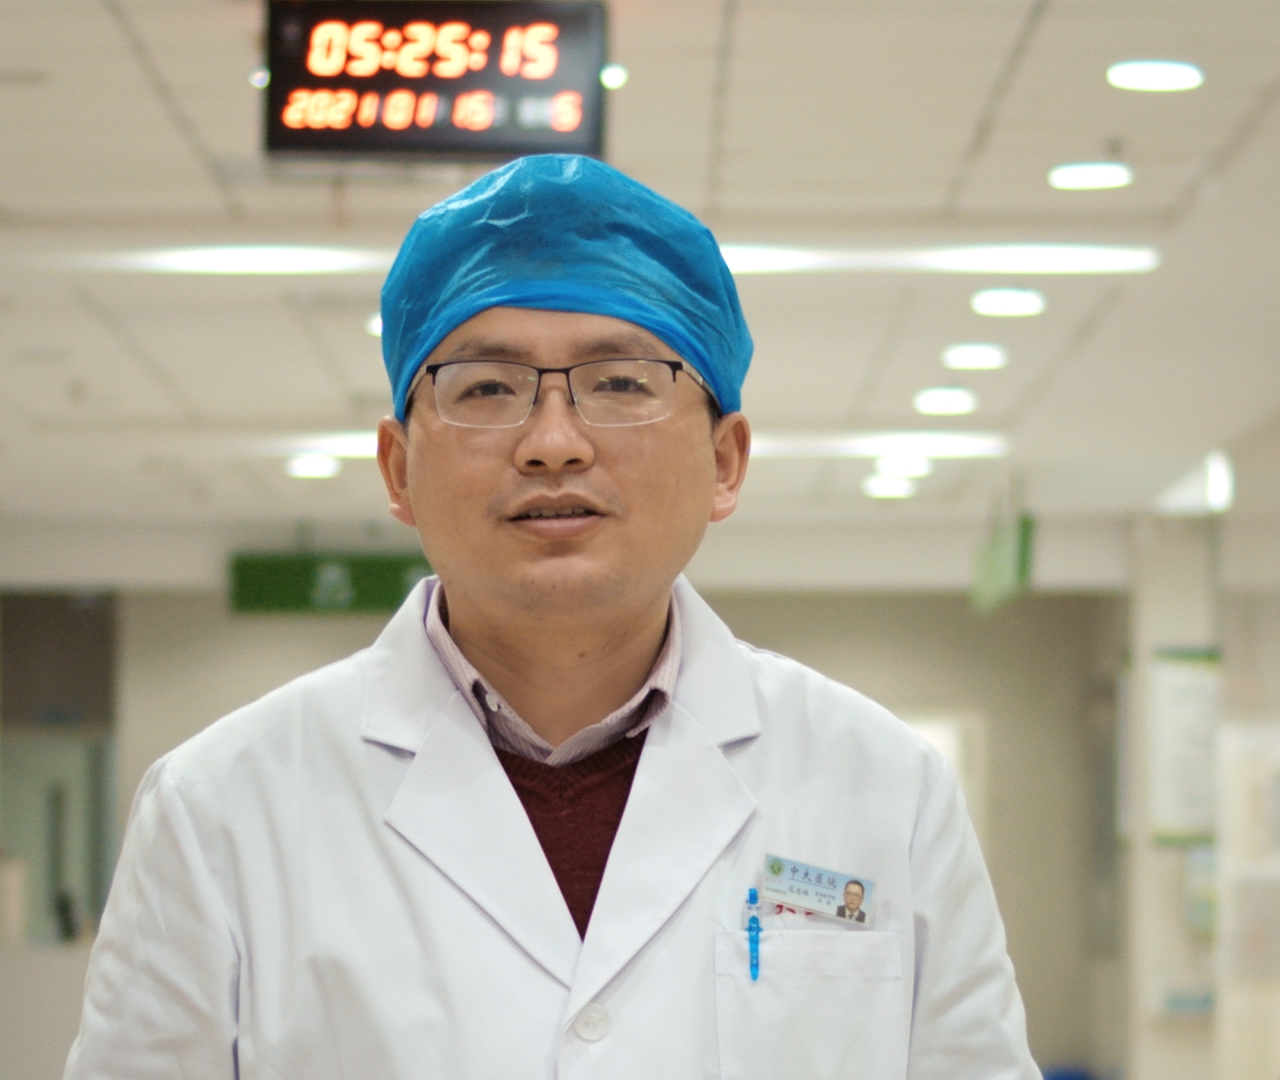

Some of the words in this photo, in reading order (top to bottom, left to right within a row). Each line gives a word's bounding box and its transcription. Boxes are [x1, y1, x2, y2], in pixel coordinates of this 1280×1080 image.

[307, 20, 559, 80] 05:25:15
[282, 89, 380, 129] 2021
[382, 89, 438, 130] 01
[790, 865, 837, 888] 中大医院
